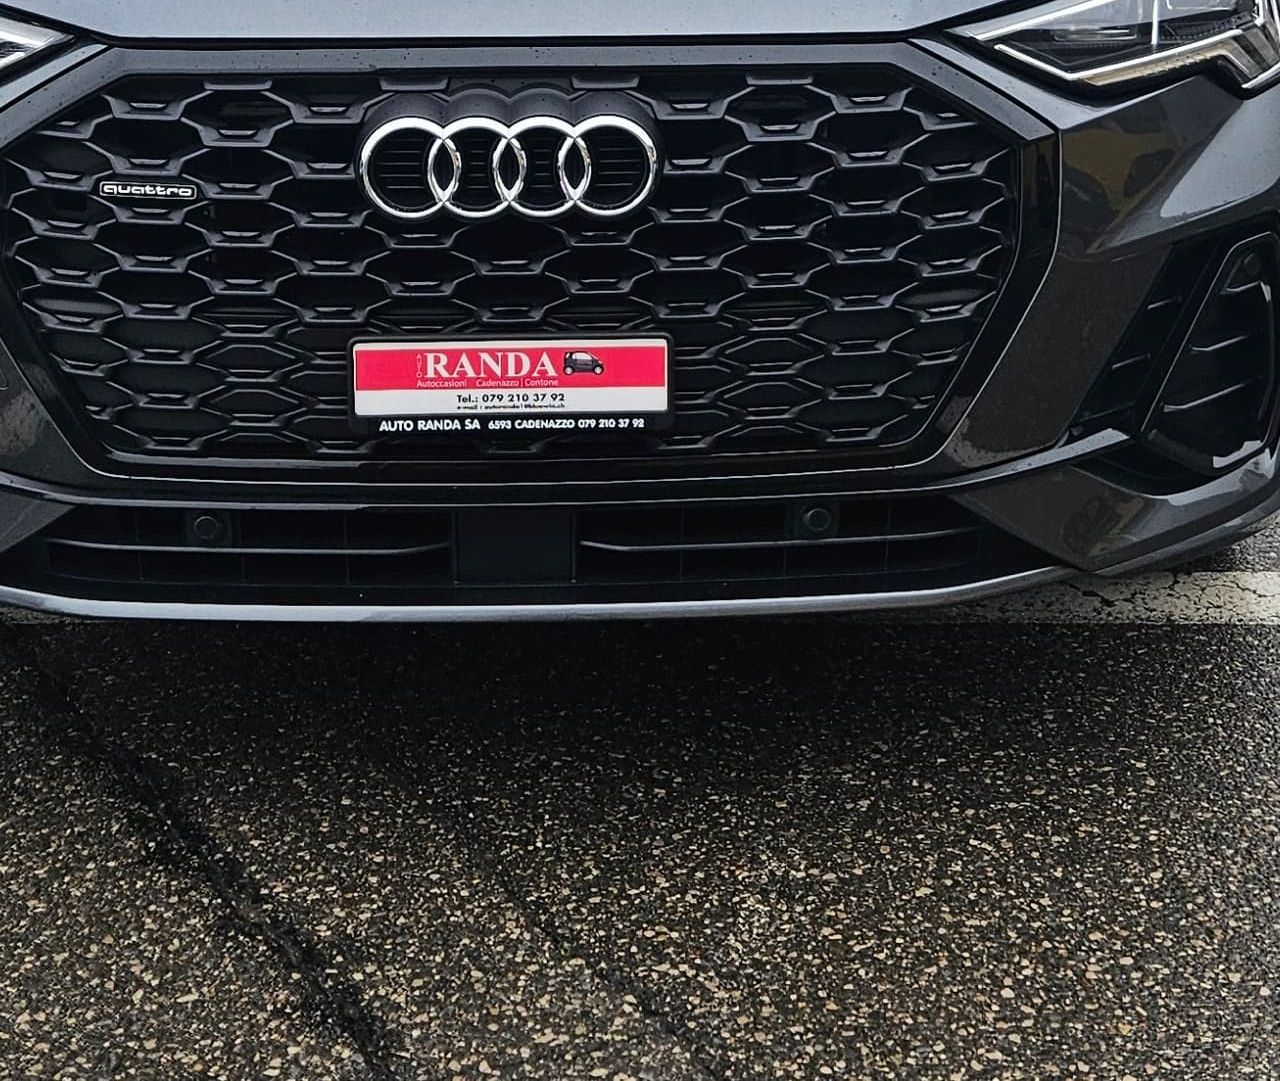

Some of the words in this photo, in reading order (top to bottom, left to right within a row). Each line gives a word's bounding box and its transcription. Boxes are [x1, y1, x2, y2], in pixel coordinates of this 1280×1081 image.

[102, 184, 193, 197] quattro
[424, 351, 559, 378] RANDA
[457, 394, 478, 403] Tel.:
[482, 394, 504, 403] 079
[508, 393, 529, 402] 210
[533, 393, 547, 402] 37
[551, 393, 565, 402] 92
[379, 420, 414, 431] AUTO
[417, 419, 461, 431] RANDA
[464, 419, 480, 430] SA
[488, 420, 512, 429] 6593
[515, 419, 575, 429] CADENAZZO
[578, 419, 596, 428] 079
[598, 419, 616, 428] 210
[618, 419, 630, 428] 37
[632, 419, 644, 428] 92
